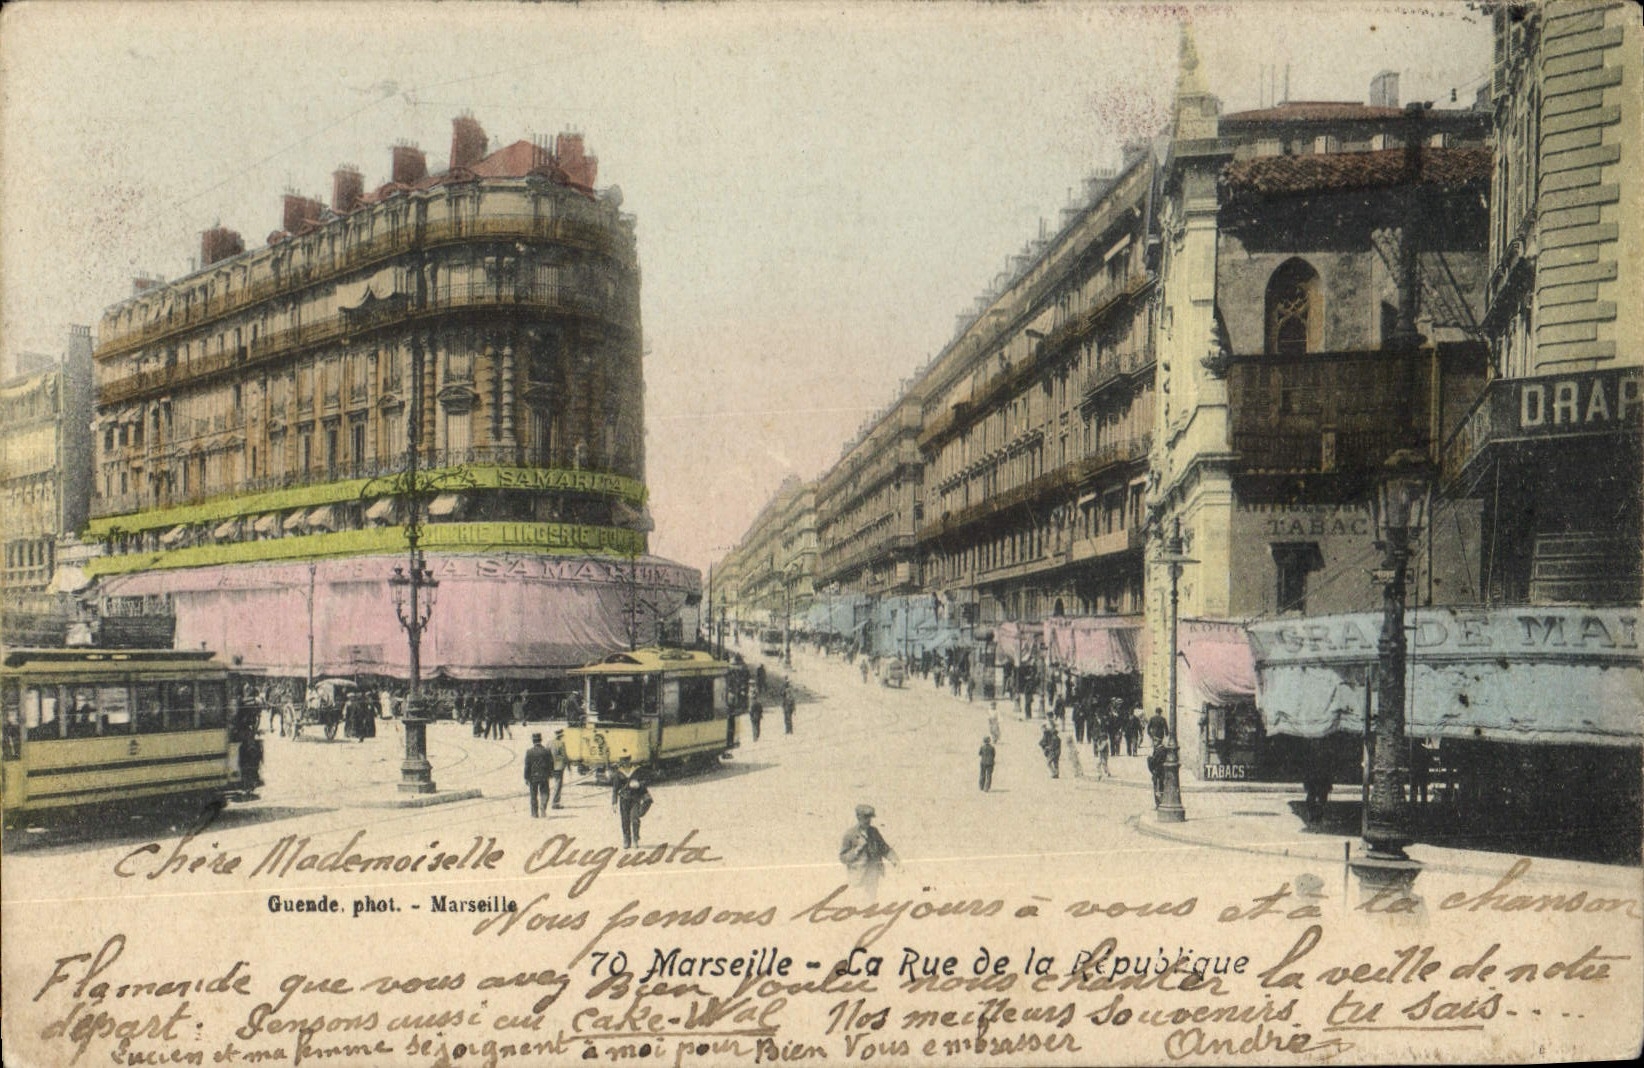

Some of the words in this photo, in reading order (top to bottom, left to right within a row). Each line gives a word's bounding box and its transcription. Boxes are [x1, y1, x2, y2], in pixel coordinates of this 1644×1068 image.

[1520, 377, 1643, 426] DRAP
[1205, 765, 1245, 779] TABACS
[249, 829, 505, 878] Mademoiselle
[524, 829, 723, 899] Augusta
[472, 893, 590, 936] Nous
[573, 900, 777, 963] pensons
[790, 884, 1004, 950] toujours
[1064, 897, 1198, 918] vous
[1217, 882, 1292, 922] et
[1440, 857, 1642, 920] chanson
[34, 933, 250, 1001] Flamande
[270, 974, 353, 1014] que
[360, 972, 465, 995] vous
[477, 970, 571, 1014] avez
[900, 973, 1018, 993] nous
[1257, 925, 1322, 988] la
[1317, 945, 1441, 985] veille
[1450, 943, 1500, 983] de
[825, 998, 891, 1035] Nos
